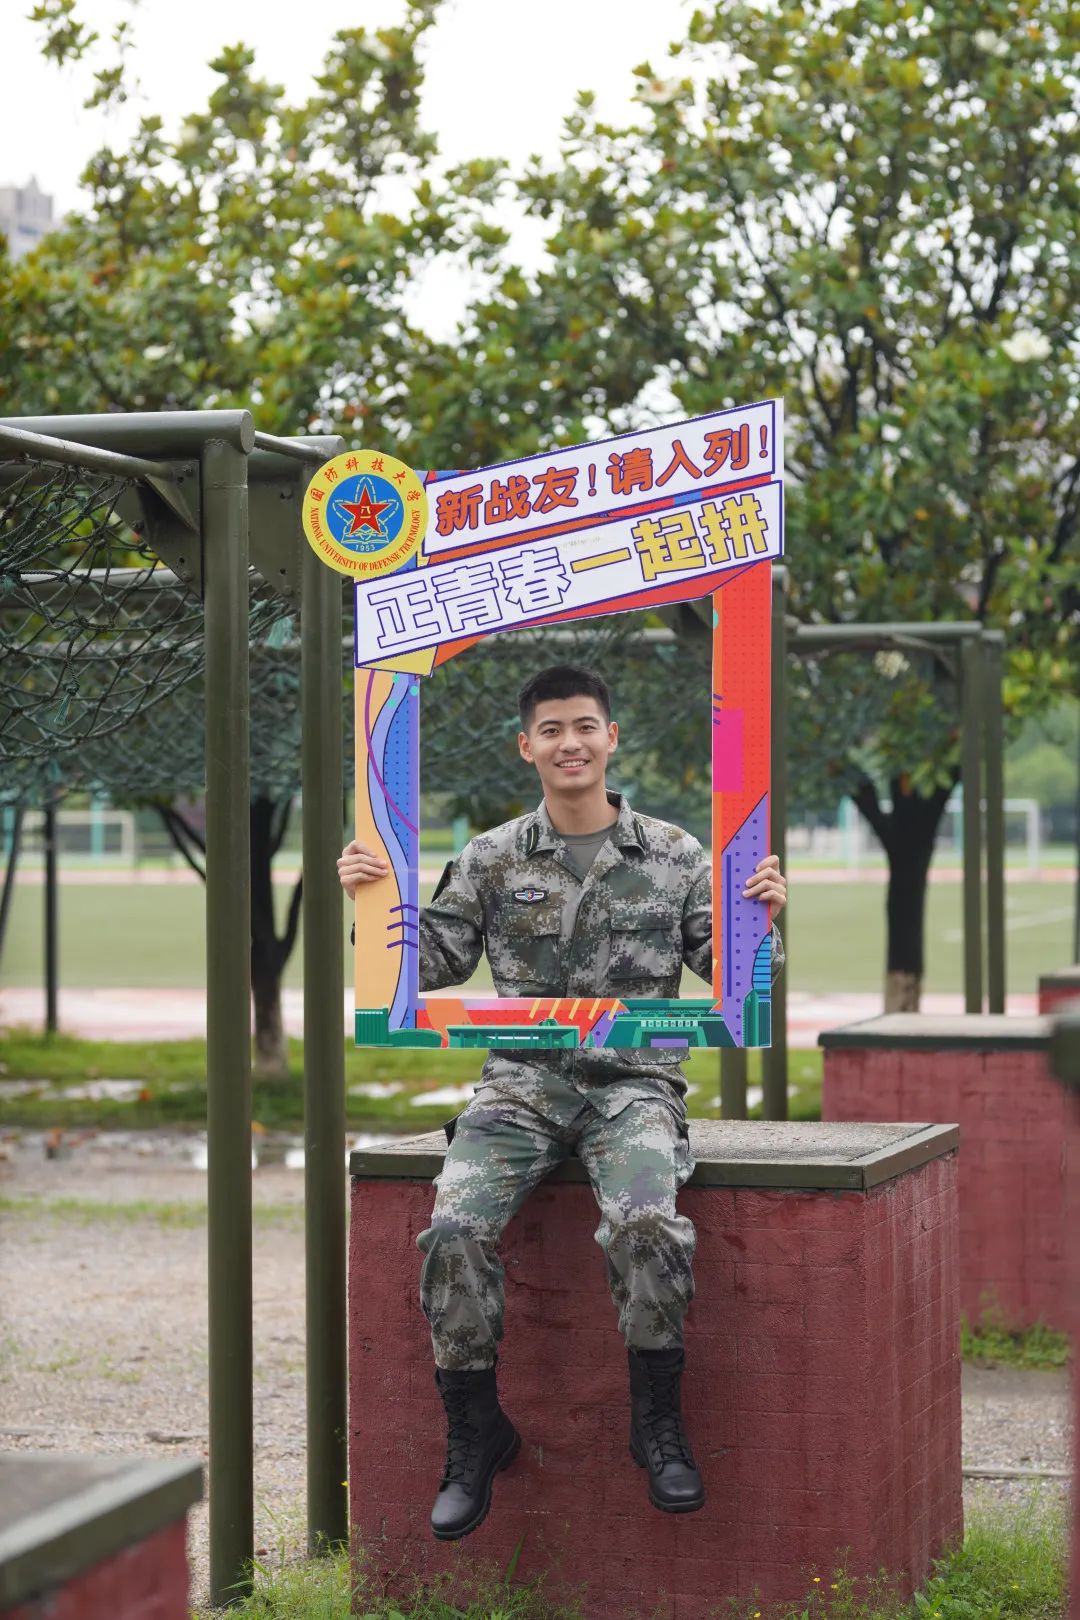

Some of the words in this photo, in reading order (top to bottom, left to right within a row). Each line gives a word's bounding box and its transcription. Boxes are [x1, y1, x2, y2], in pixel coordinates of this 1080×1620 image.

[310, 507, 323, 542] NATIONAL
[319, 540, 359, 571] UNIVERSITY
[359, 561, 369, 571] OF
[369, 552, 402, 571] DEFENSE
[399, 509, 421, 556] TECHNOLOGY
[367, 493, 770, 650] 正青春一起拼
